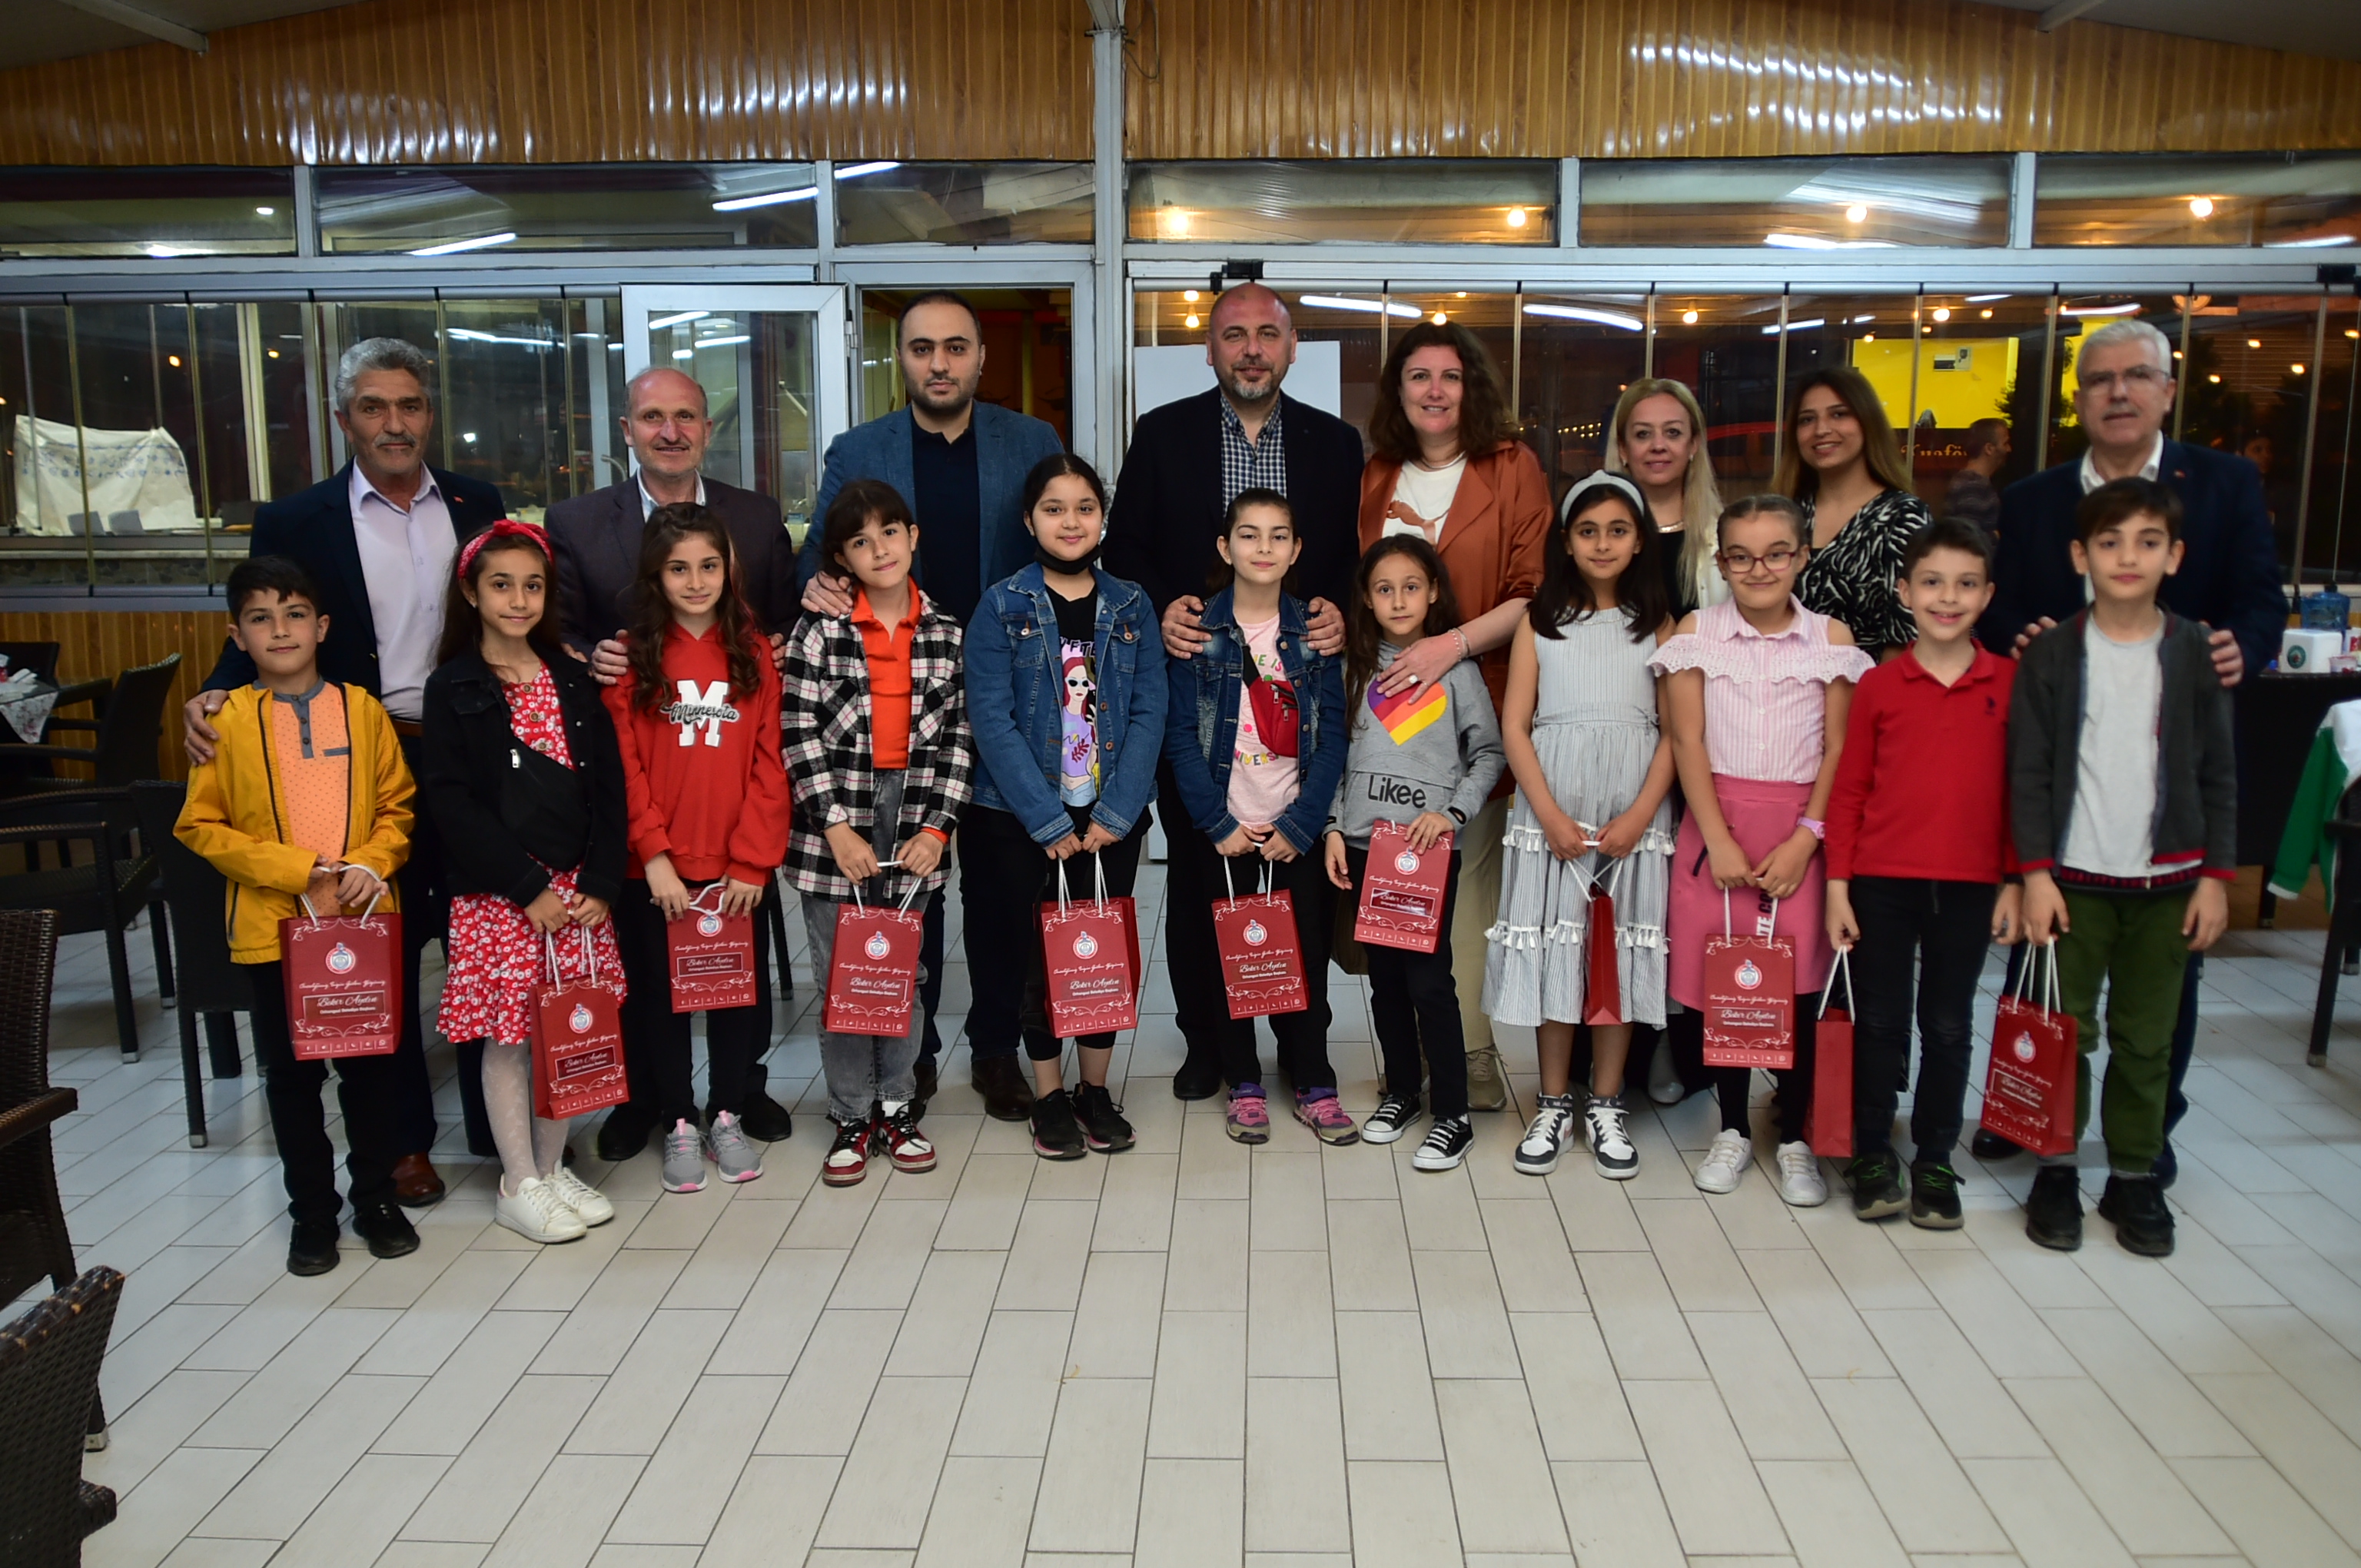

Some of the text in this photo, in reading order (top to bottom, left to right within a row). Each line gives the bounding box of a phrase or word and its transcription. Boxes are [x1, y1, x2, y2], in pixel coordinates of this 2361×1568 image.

[676, 679, 728, 747] M
[1368, 775, 1426, 809] Likee
[1070, 980, 1092, 990] Bekir
